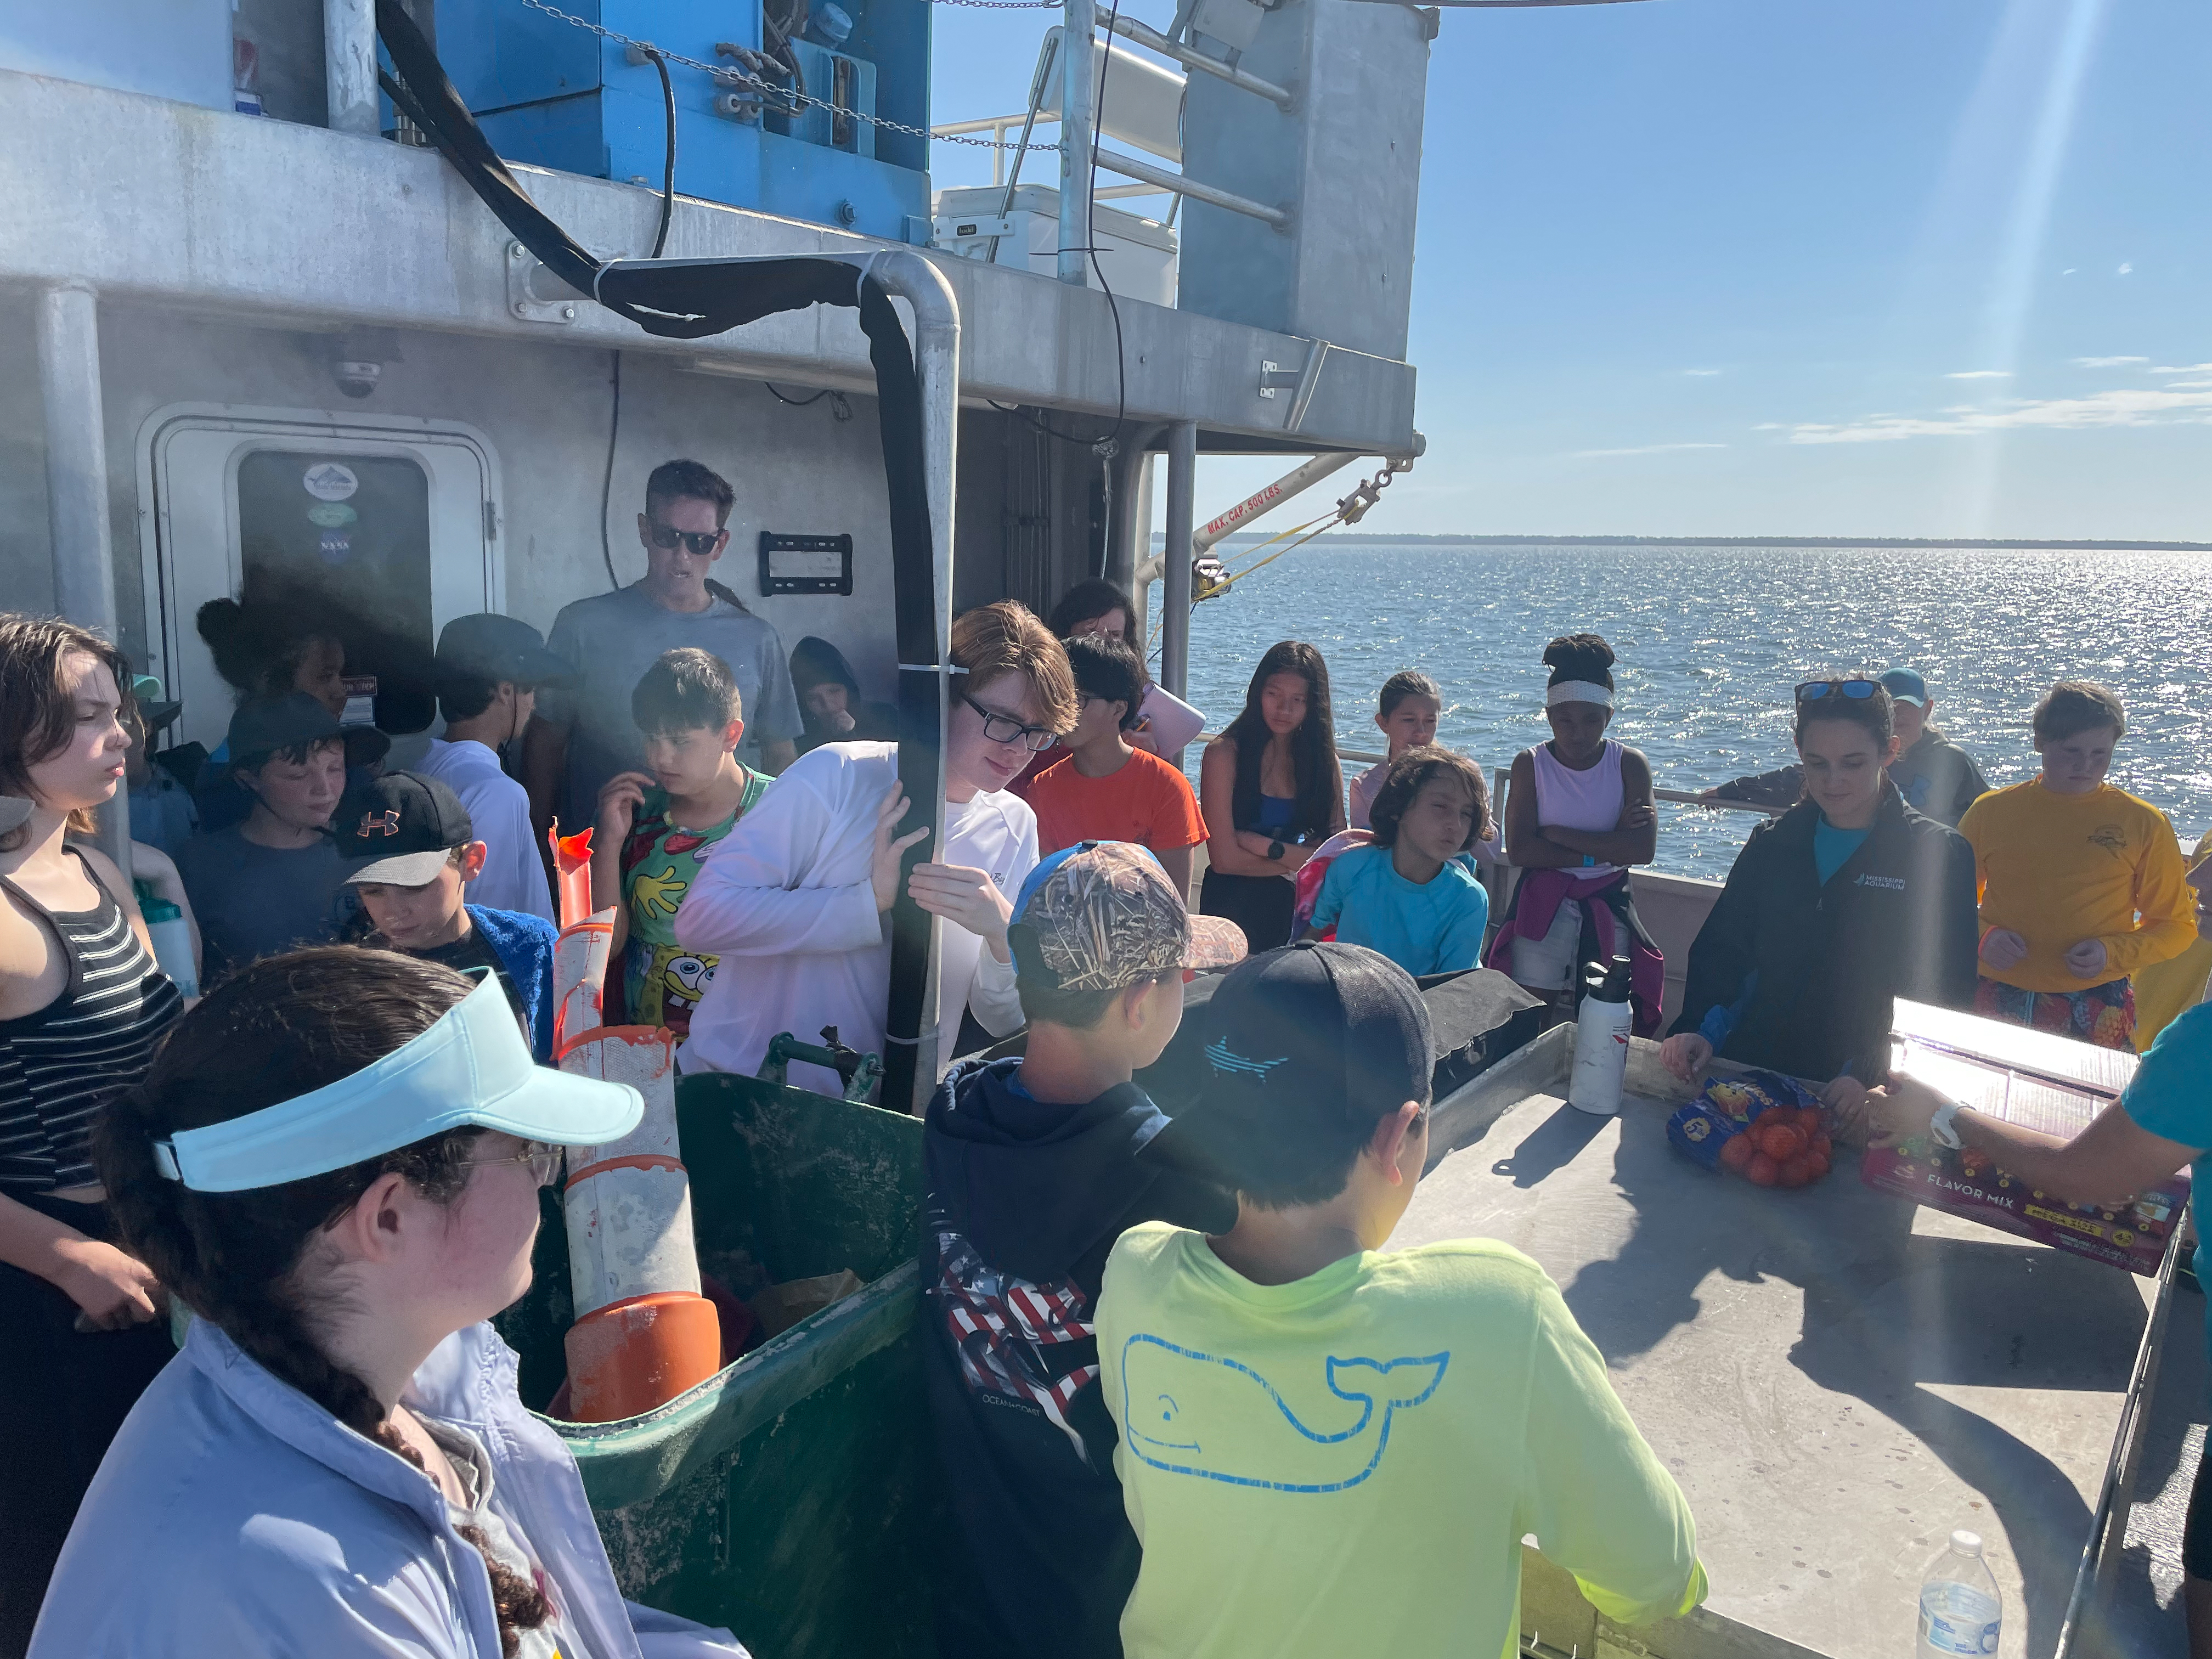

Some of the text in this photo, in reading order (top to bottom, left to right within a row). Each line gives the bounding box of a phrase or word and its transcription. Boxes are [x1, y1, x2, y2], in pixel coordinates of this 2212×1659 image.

[1207, 483, 1283, 535] MAX. CAP. 500 LBS.
[1864, 880, 1904, 891] AQUARIUM
[1866, 874, 1906, 885] MISSISSIPPI
[1686, 1121, 1703, 1134] 5
[1927, 1173, 1983, 1199] FLAVOR
[1986, 1192, 2015, 1209] MIX
